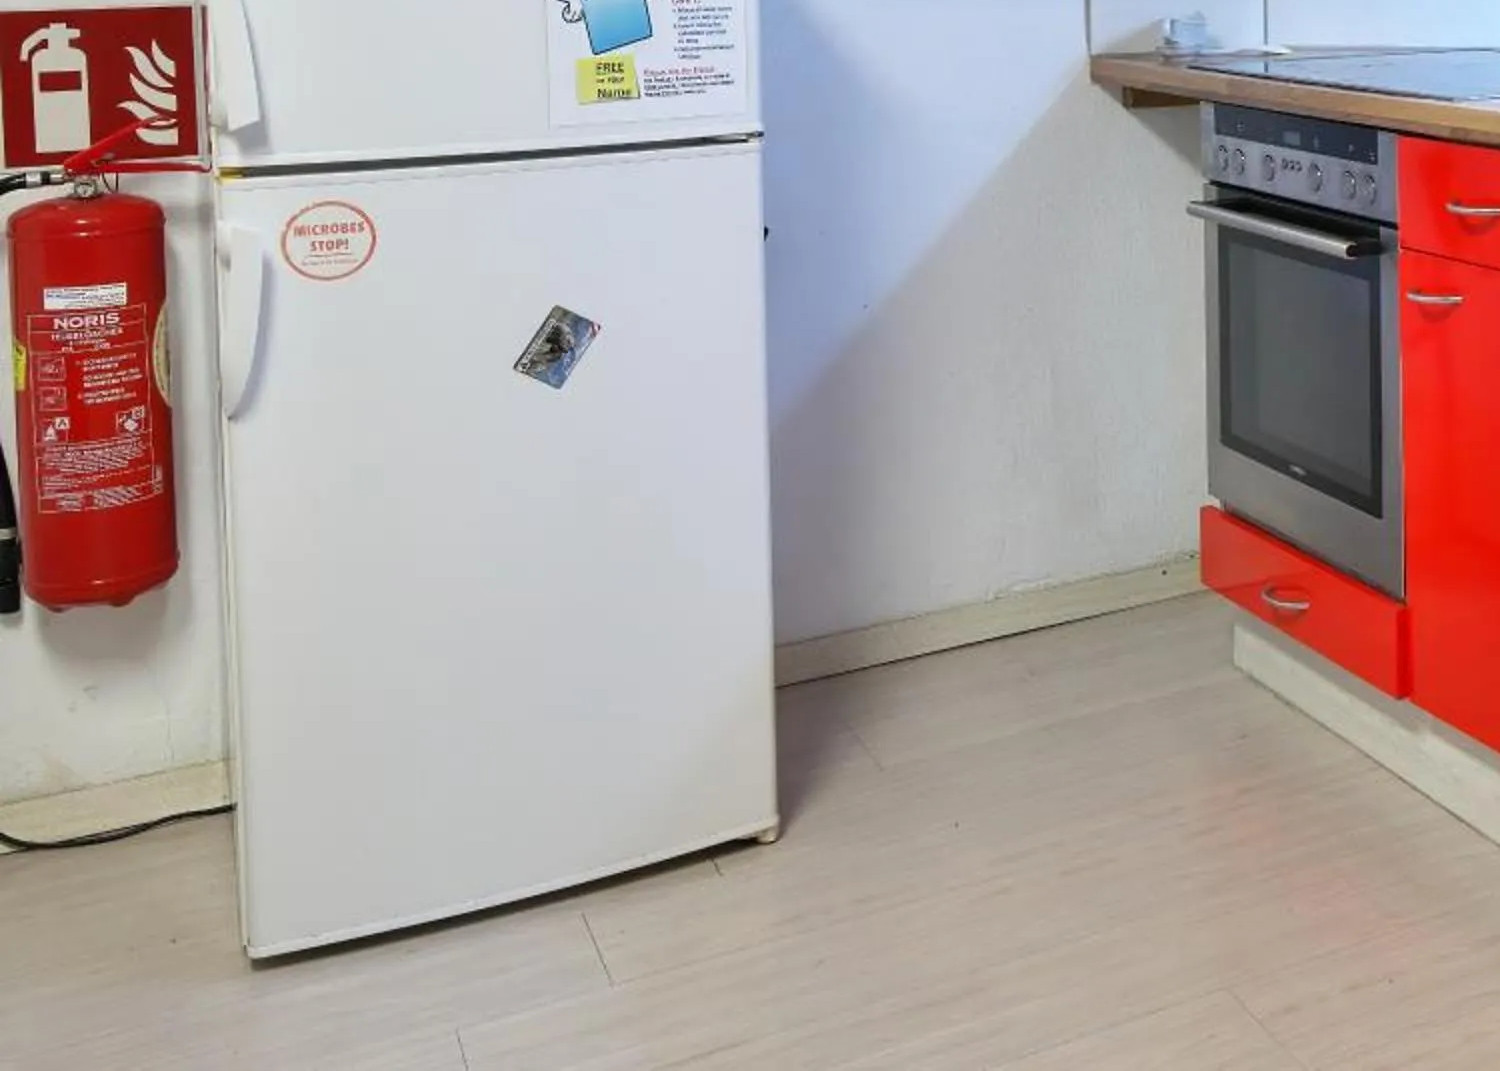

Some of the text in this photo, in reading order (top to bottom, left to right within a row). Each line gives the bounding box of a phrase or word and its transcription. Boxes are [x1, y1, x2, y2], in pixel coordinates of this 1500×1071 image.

[293, 221, 365, 237] MICROBES
[310, 238, 349, 251] STOP!
[53, 313, 121, 330] NORIS
